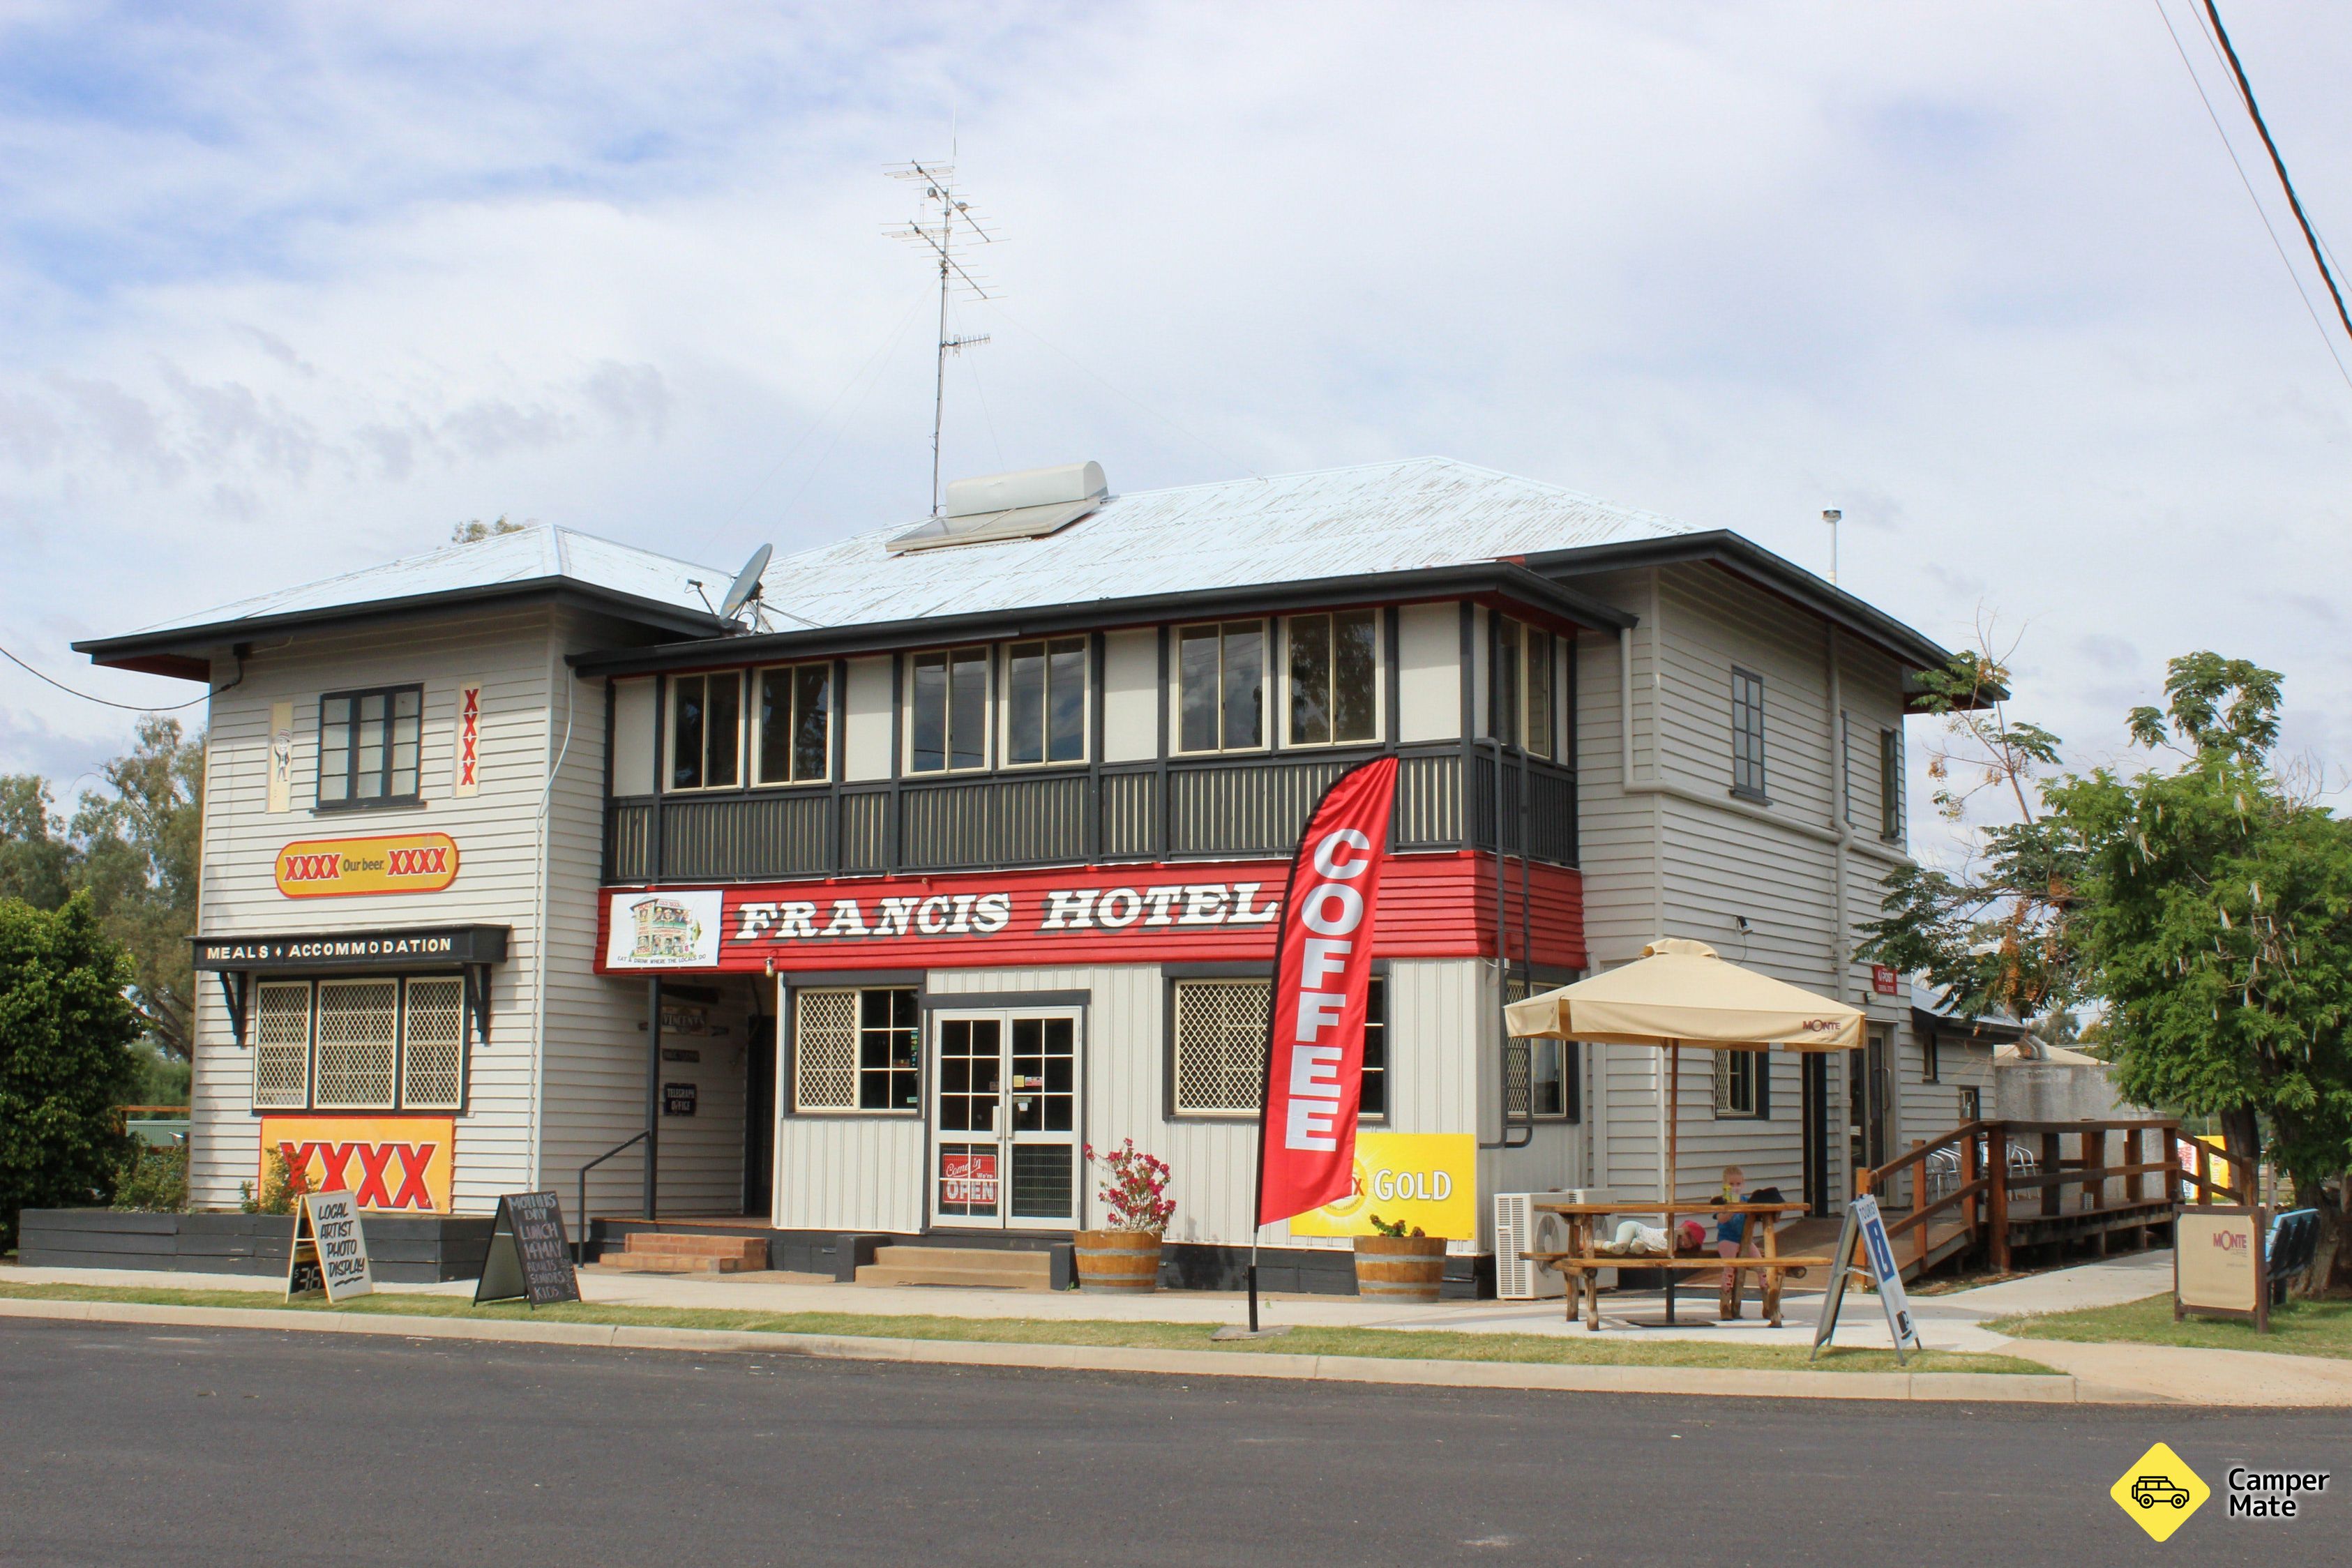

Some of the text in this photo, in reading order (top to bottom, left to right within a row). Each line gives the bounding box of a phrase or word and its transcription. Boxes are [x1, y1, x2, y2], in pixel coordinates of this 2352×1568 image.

[460, 688, 479, 785] XXXX
[283, 853, 342, 881] XXXX
[343, 859, 361, 872] Our
[387, 847, 448, 875] XXXX
[734, 882, 1279, 940] FRANCIS HOTEL
[206, 938, 451, 960] MEALS ACCOMMODATION
[1285, 827, 1371, 1152] COFFEE
[1802, 1019, 1841, 1032] MONTE
[667, 1088, 695, 1099] TELEGRAPH
[671, 1100, 691, 1111] OFFICE
[946, 1158, 981, 1177] Come in
[947, 1181, 994, 1200] OPEN
[1373, 1168, 1452, 1201] GOLD
[318, 1203, 349, 1220] LOCAL
[525, 1208, 547, 1220] DAY
[320, 1221, 354, 1239] ARTIST
[519, 1222, 558, 1240] LUNCH
[326, 1239, 358, 1258] PHOTO
[2212, 1230, 2247, 1251] MONTE
[329, 1257, 365, 1277] DISPLAY
[527, 1260, 557, 1273] ADULTS
[529, 1271, 566, 1285] SENIORS
[534, 1286, 560, 1301] KIDS
